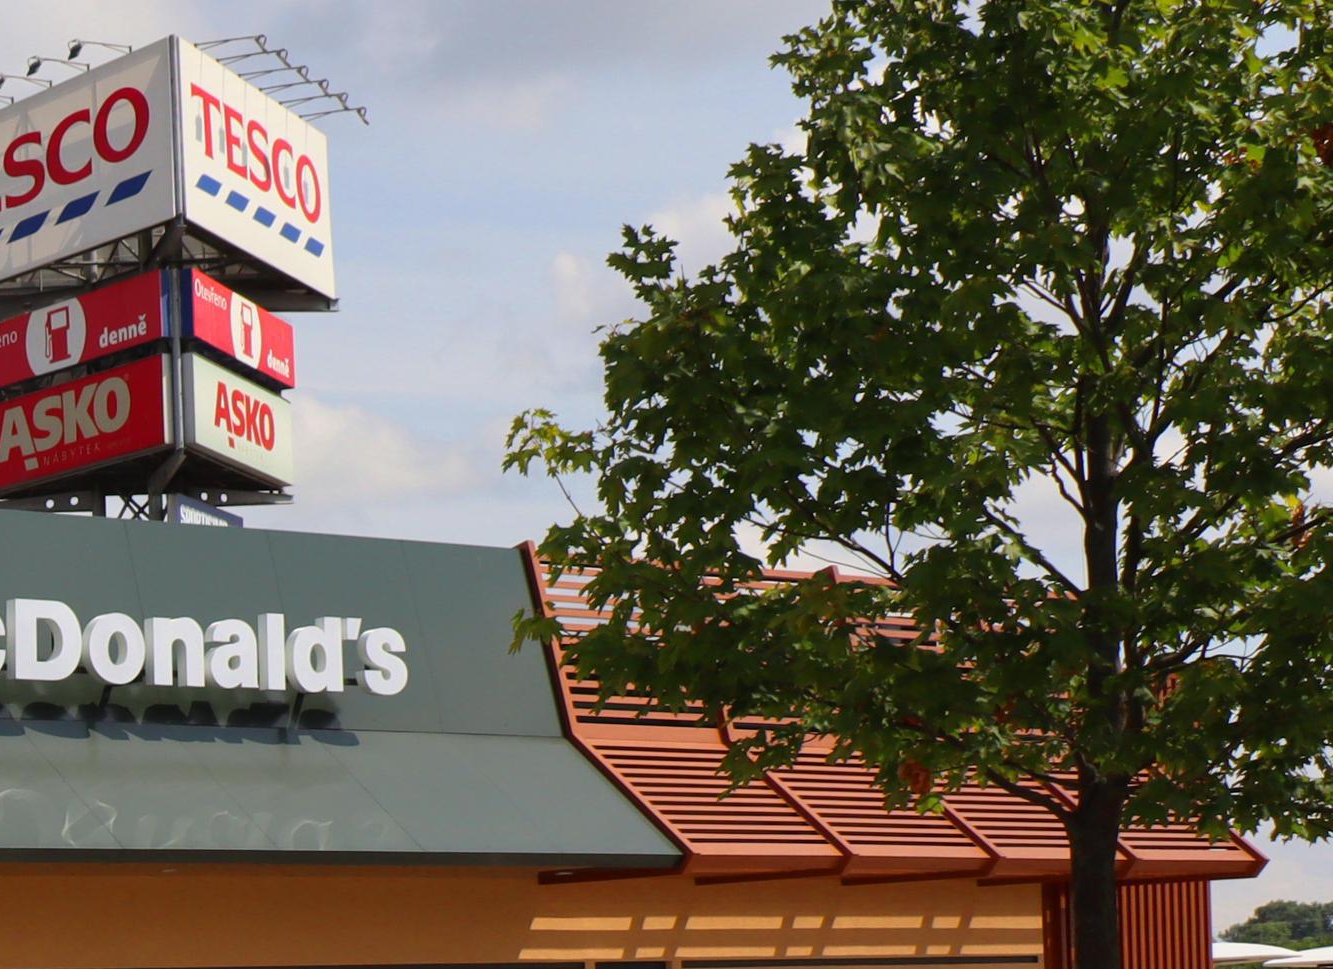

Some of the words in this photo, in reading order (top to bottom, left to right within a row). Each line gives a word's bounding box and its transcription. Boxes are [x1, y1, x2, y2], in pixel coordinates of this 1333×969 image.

[190, 82, 322, 224] TESCO
[99, 314, 147, 348] denně
[195, 279, 227, 311] Otevřeno
[267, 349, 290, 378] denně
[214, 381, 275, 452] ASKO
